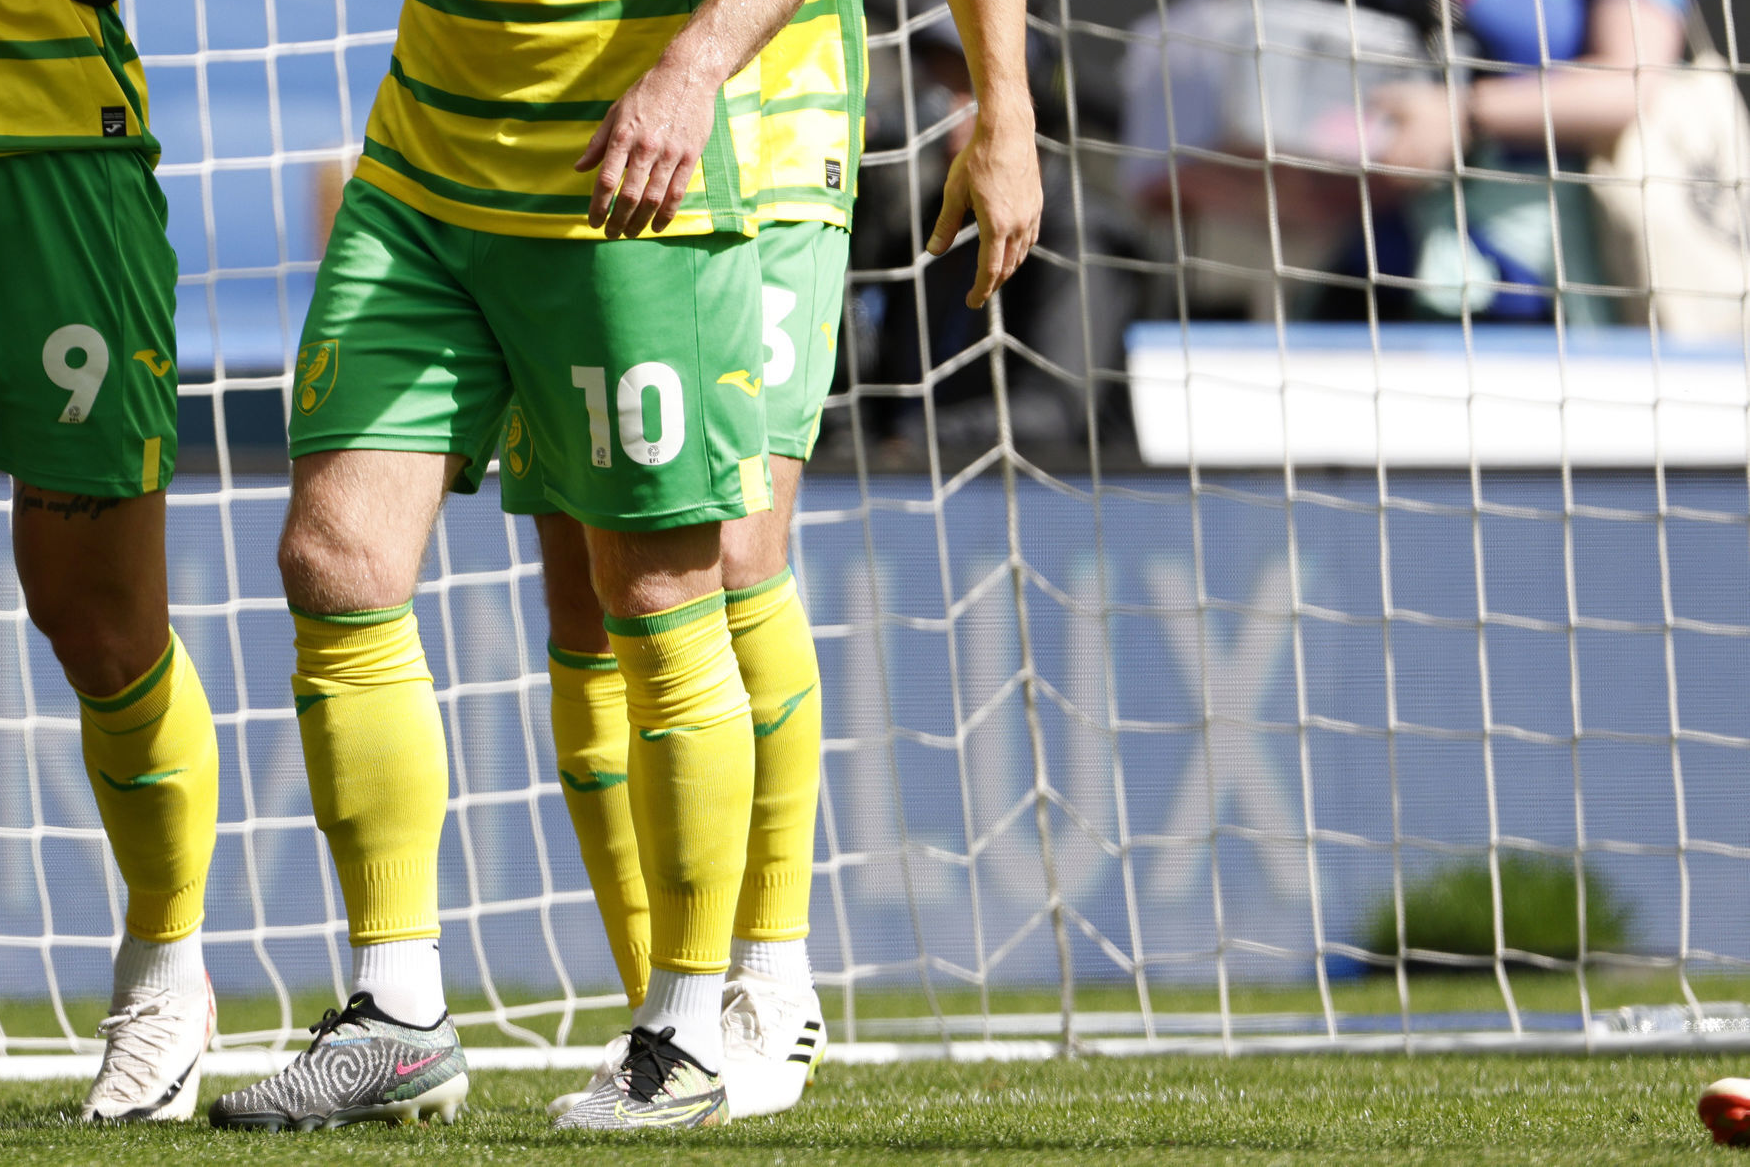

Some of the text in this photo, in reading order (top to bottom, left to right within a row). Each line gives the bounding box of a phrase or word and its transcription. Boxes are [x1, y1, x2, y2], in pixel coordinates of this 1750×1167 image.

[42, 323, 110, 423] 9
[571, 361, 686, 468] 10
[846, 555, 1324, 907] LUX
